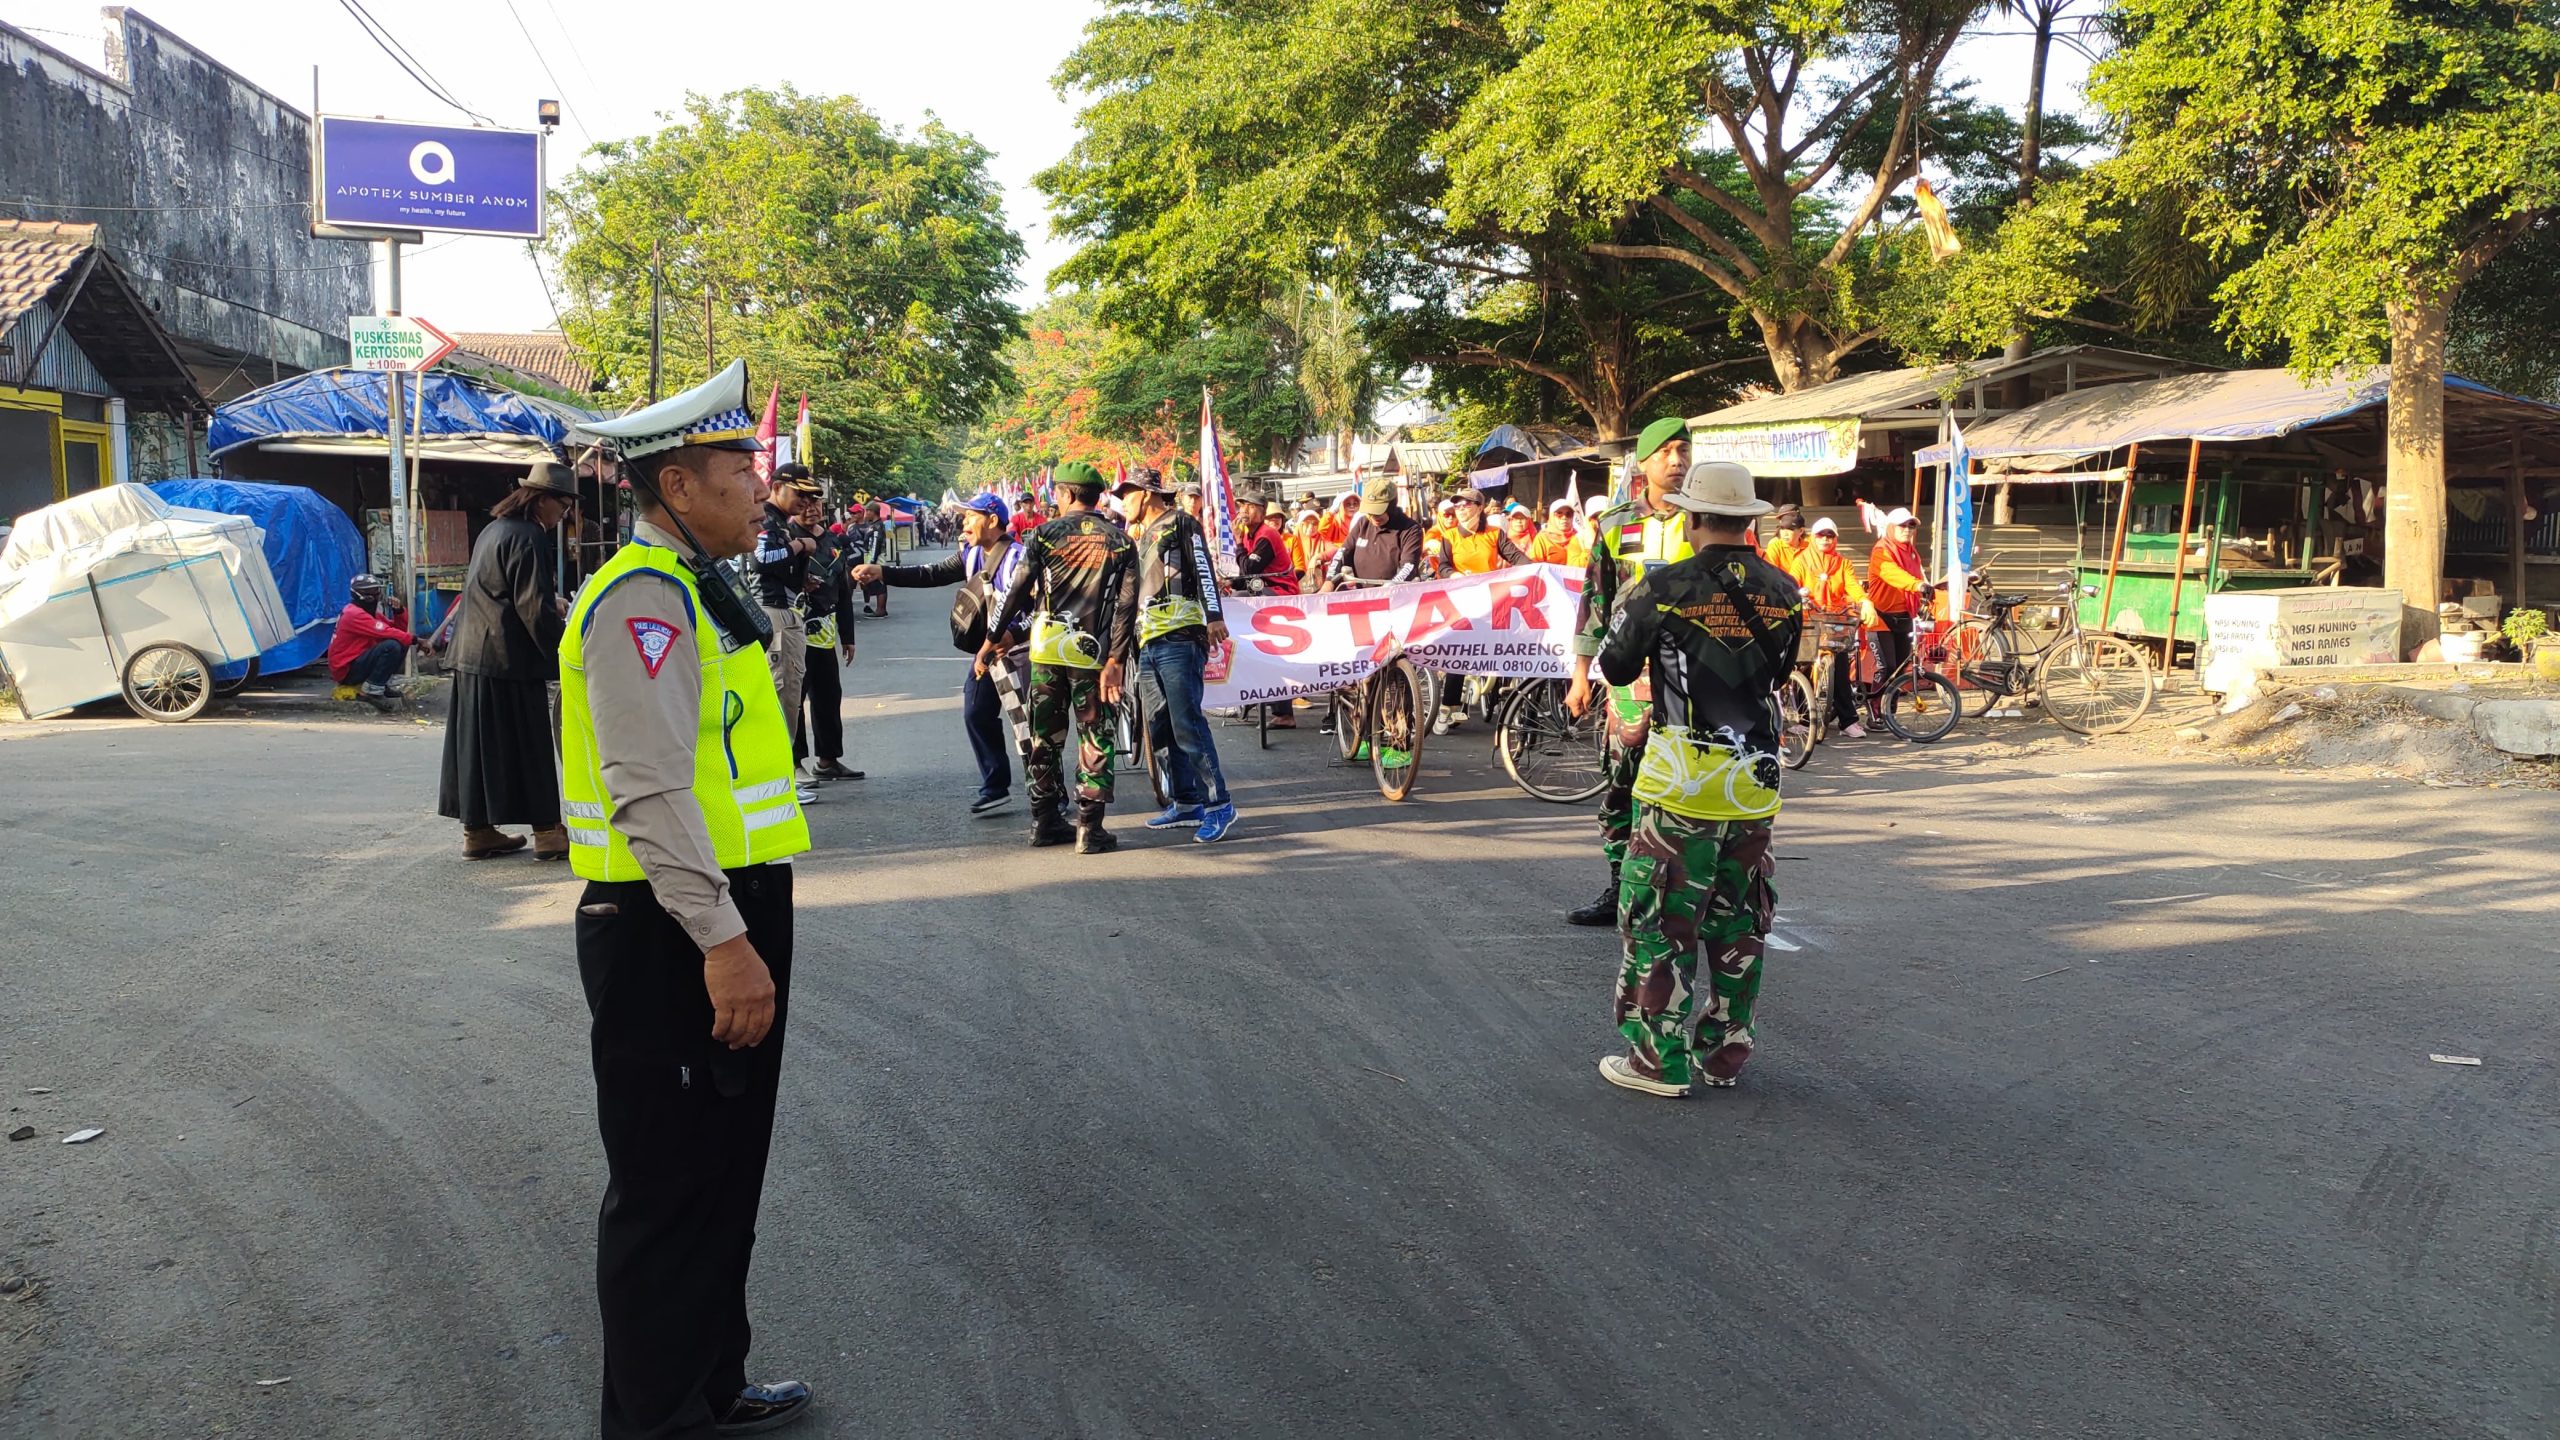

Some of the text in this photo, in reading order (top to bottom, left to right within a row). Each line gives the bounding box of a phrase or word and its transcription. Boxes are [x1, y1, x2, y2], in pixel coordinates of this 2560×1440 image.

[337, 186, 528, 208] APOTEK SUMBER ANOM
[446, 209, 466, 217] future
[354, 331, 422, 345] PUSKESMAS
[355, 346, 424, 359] KERTOSONO
[1194, 549, 1220, 612] KERTOSONO
[2292, 621, 2357, 636] NASI KUNING
[1494, 643, 1565, 656] BARENG
[2292, 637, 2350, 651] NASI RAMES
[2290, 654, 2338, 665] NASI BALI
[1240, 686, 1288, 701] DALAM
[1441, 659, 1499, 672] KORAMIL
[1503, 661, 1558, 673] 0810/06
